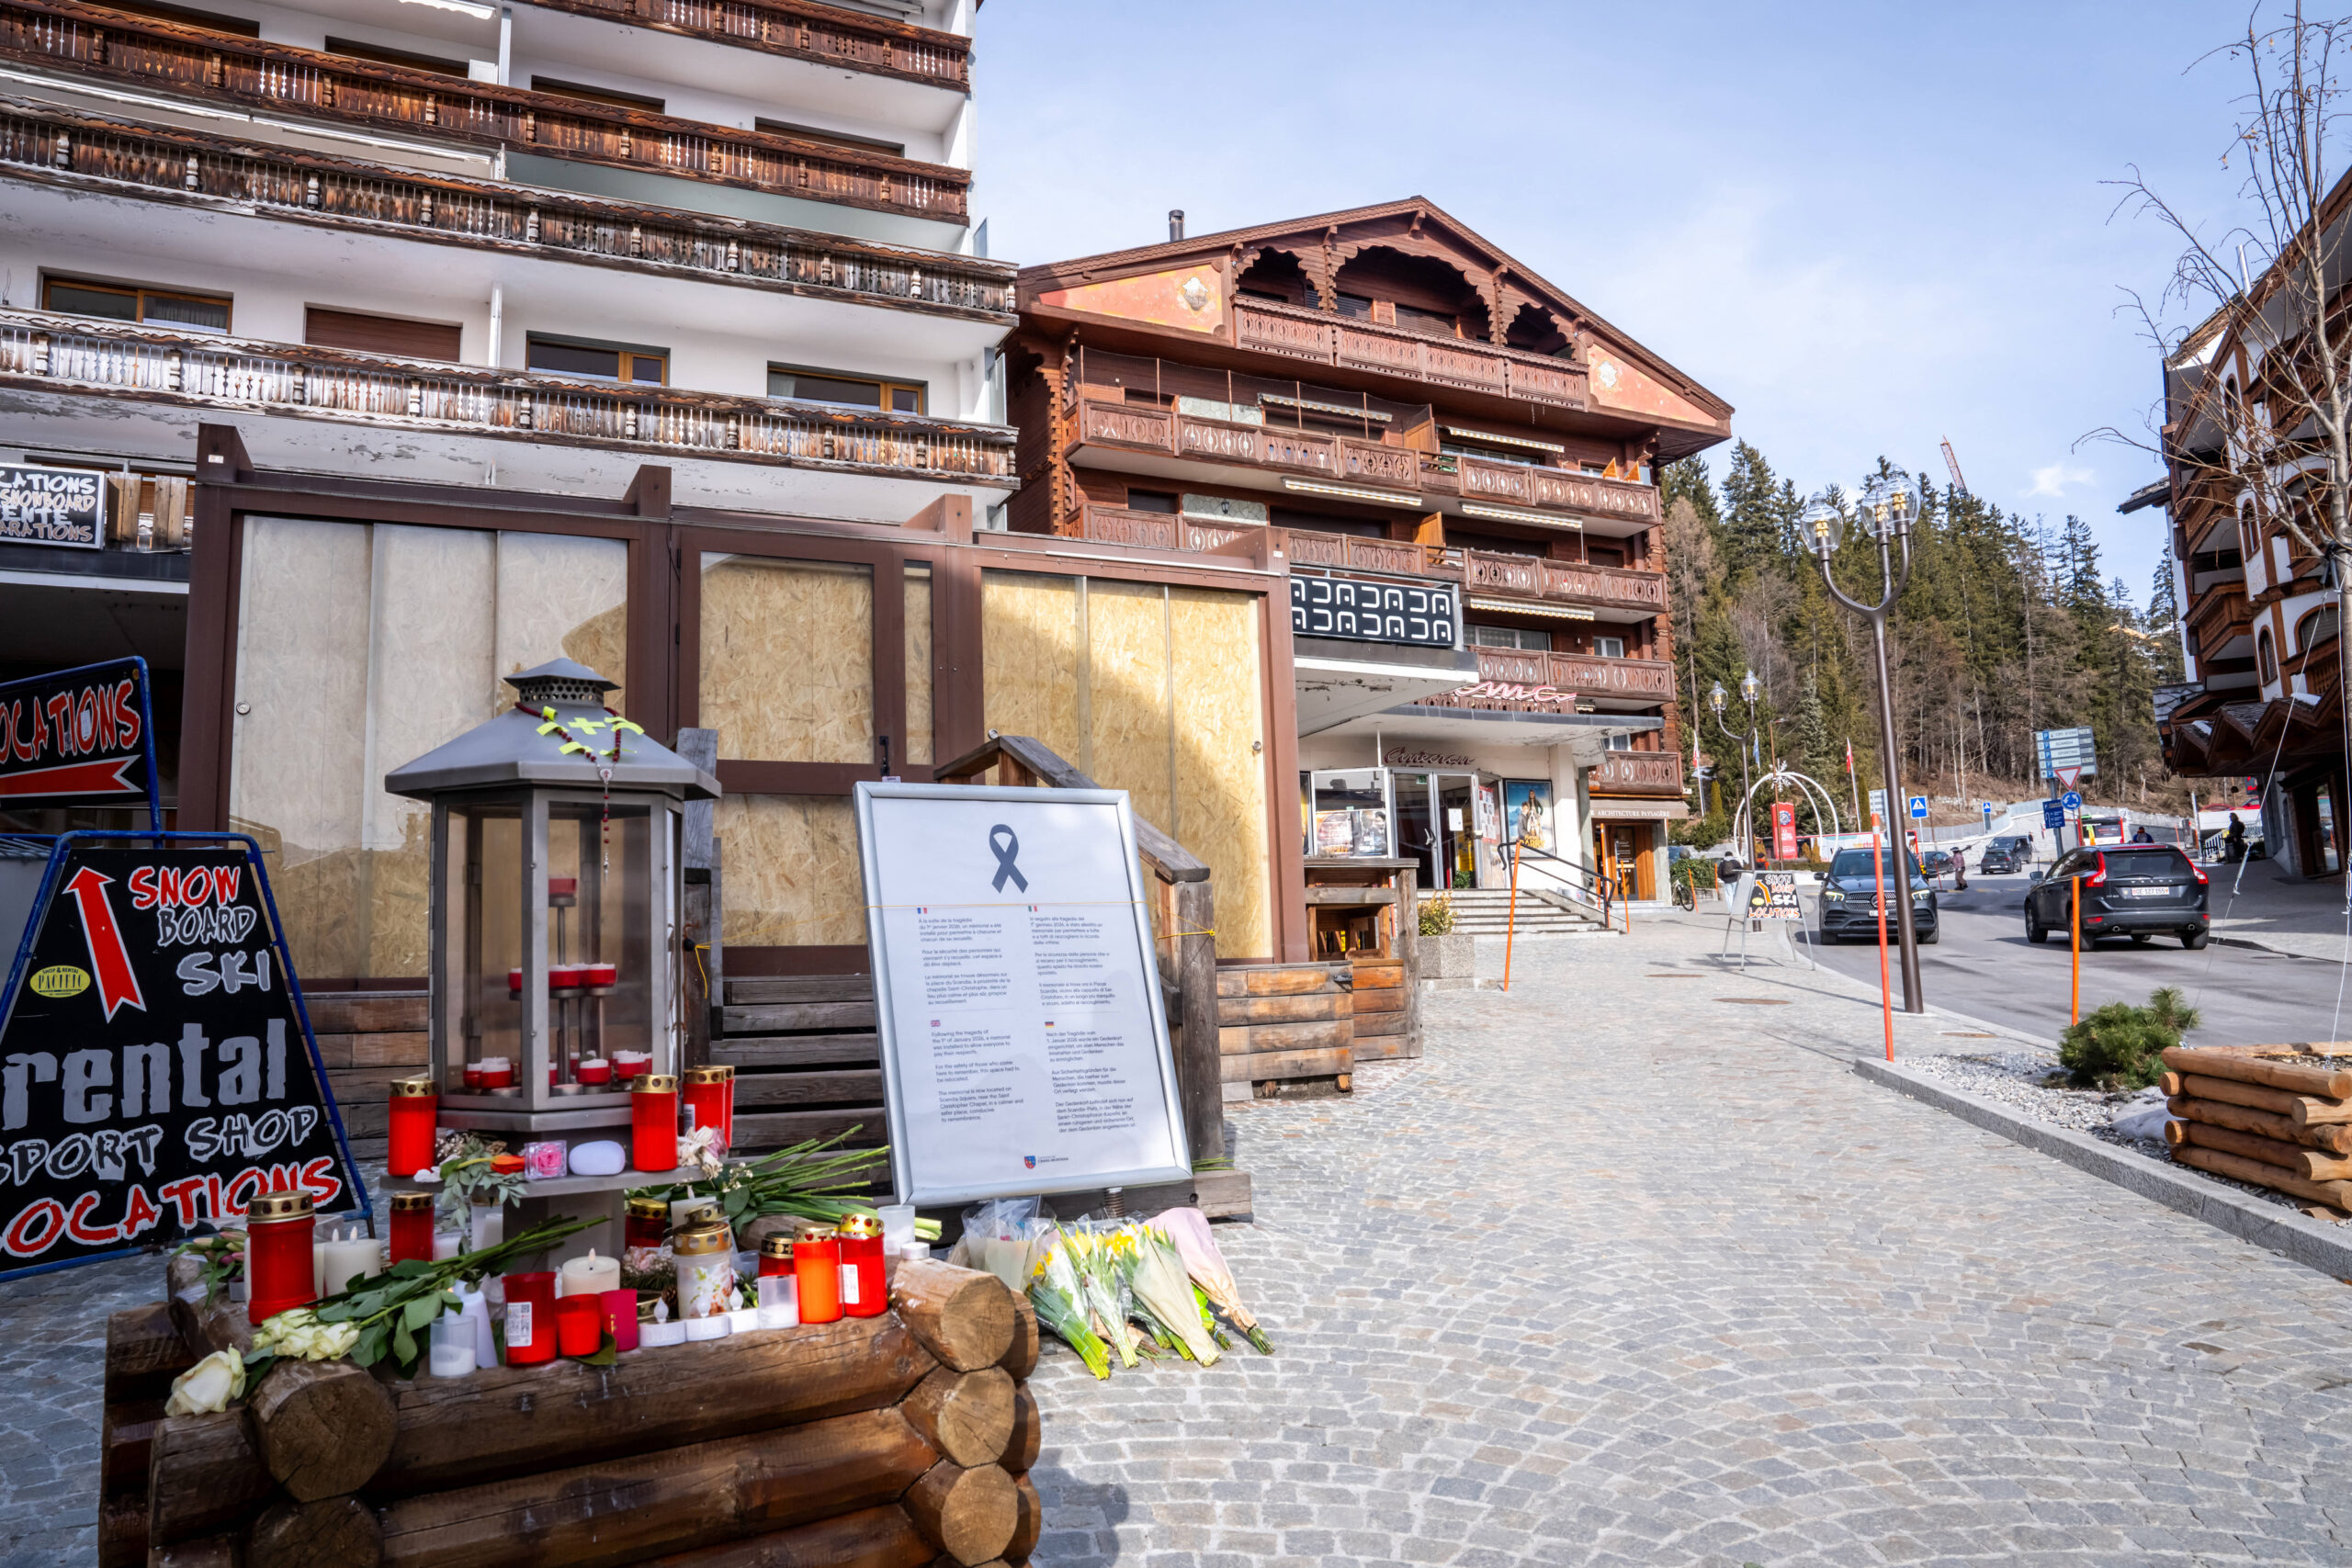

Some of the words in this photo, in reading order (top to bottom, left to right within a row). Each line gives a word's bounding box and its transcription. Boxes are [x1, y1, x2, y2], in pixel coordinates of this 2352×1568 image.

[0, 488, 96, 513] SNOWBOARD
[0, 678, 141, 764] OCATIONS
[129, 865, 240, 909] SNOW
[1765, 874, 1792, 885] SNOW
[1772, 894, 1797, 906] SKI
[157, 906, 257, 947] BOARD
[1748, 907, 1800, 919] LOCATIONS
[39, 974, 84, 989] PACIFIC
[176, 949, 270, 996] SKI
[2, 1018, 288, 1131] rental
[185, 1106, 318, 1162] SHOP
[0, 1156, 343, 1258] OCATIONS
